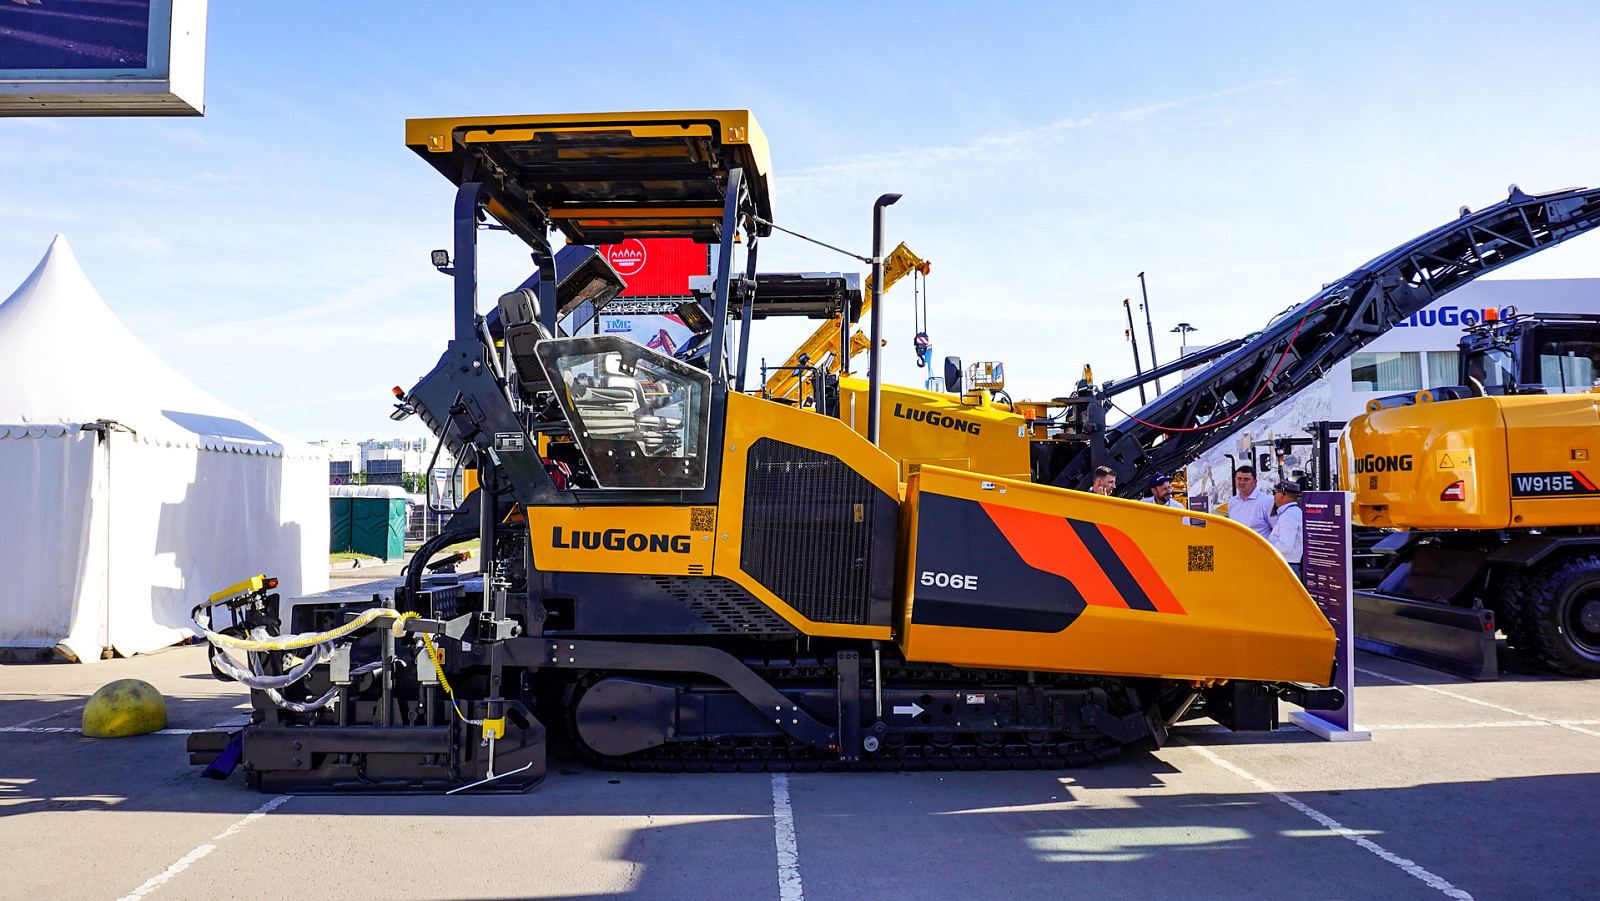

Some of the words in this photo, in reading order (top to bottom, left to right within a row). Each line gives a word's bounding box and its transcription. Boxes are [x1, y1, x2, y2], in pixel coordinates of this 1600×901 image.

[605, 319, 631, 329] TMC
[1517, 475, 1574, 492] W915E
[920, 570, 978, 591] 506E
